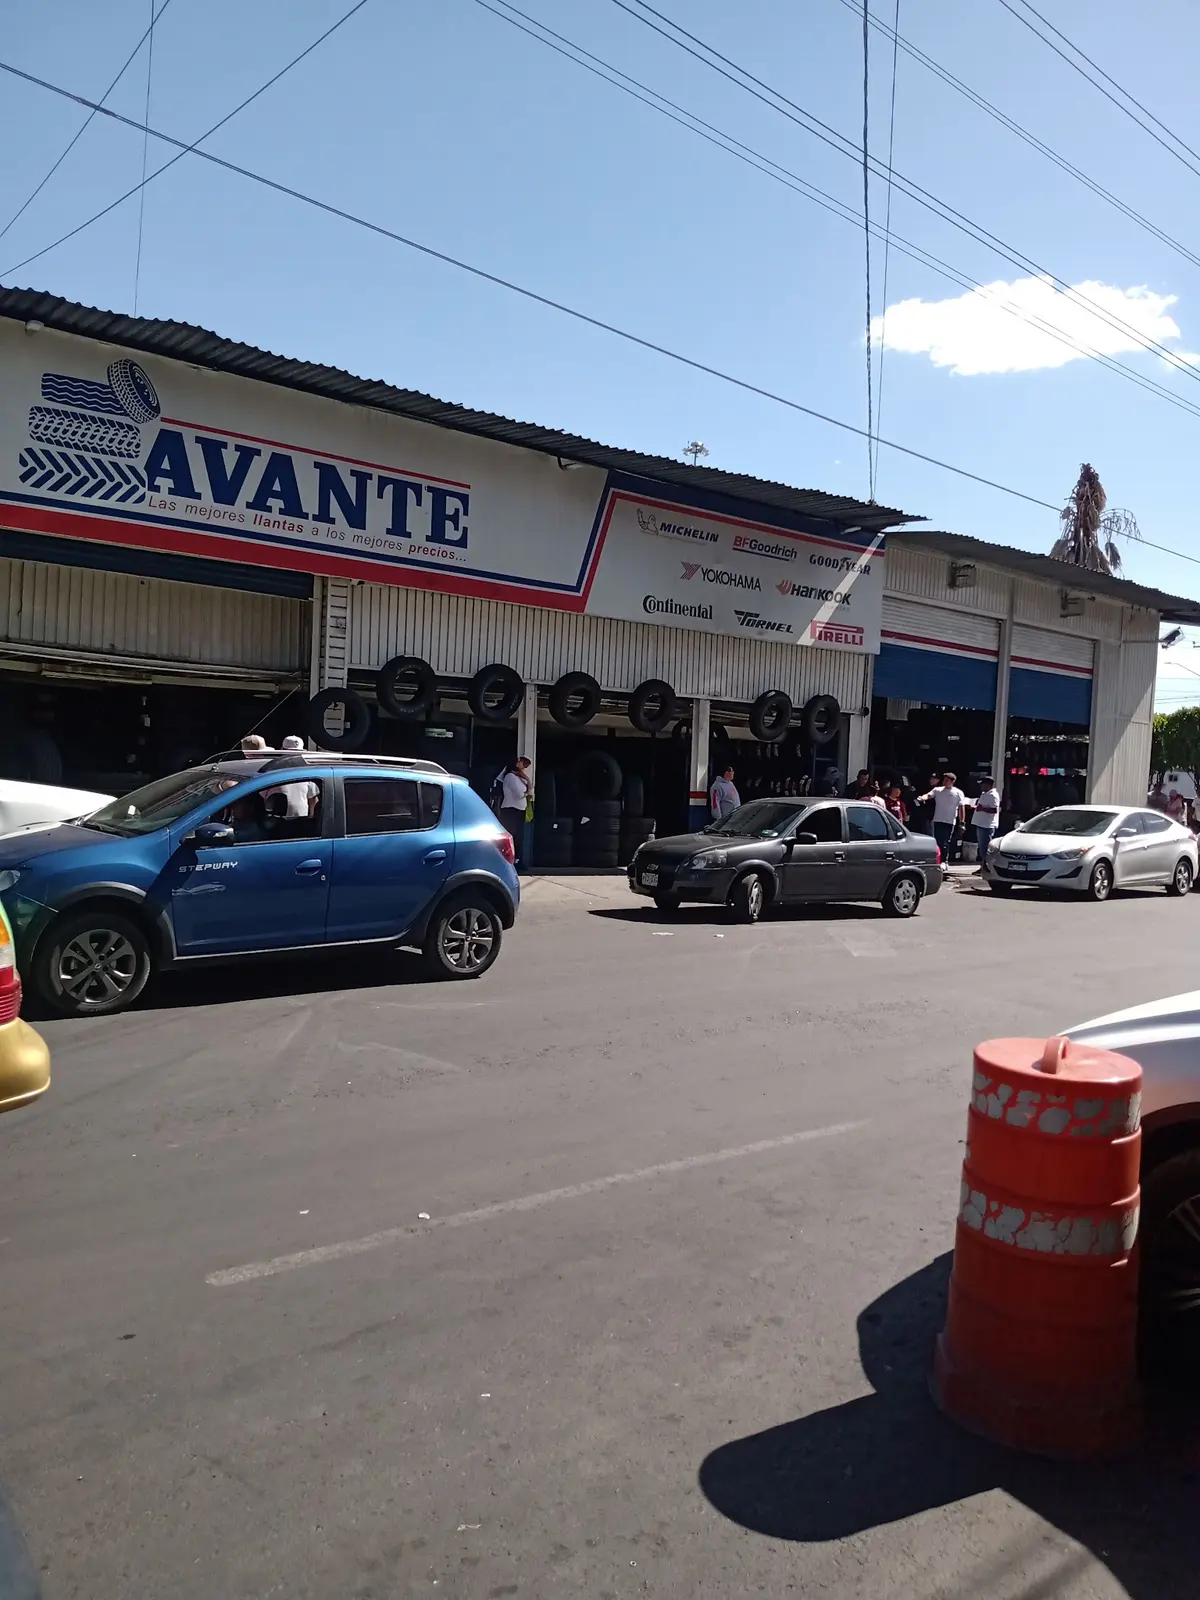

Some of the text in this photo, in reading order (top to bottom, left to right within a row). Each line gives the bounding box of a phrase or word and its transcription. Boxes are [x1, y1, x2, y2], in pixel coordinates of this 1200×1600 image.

[144, 428, 470, 549] AVANTE
[148, 495, 467, 562] Las mejores llantas a los mejores precios...
[659, 522, 720, 543] MICHELIN
[733, 535, 798, 560] BFGoodrich
[809, 554, 872, 576] GOODYEAR
[701, 566, 763, 593] YOKOHAMA
[642, 594, 714, 621] Continental
[733, 609, 795, 635] TORNEL
[809, 619, 865, 646] PIRELLI
[178, 861, 239, 873] STEPWAY
